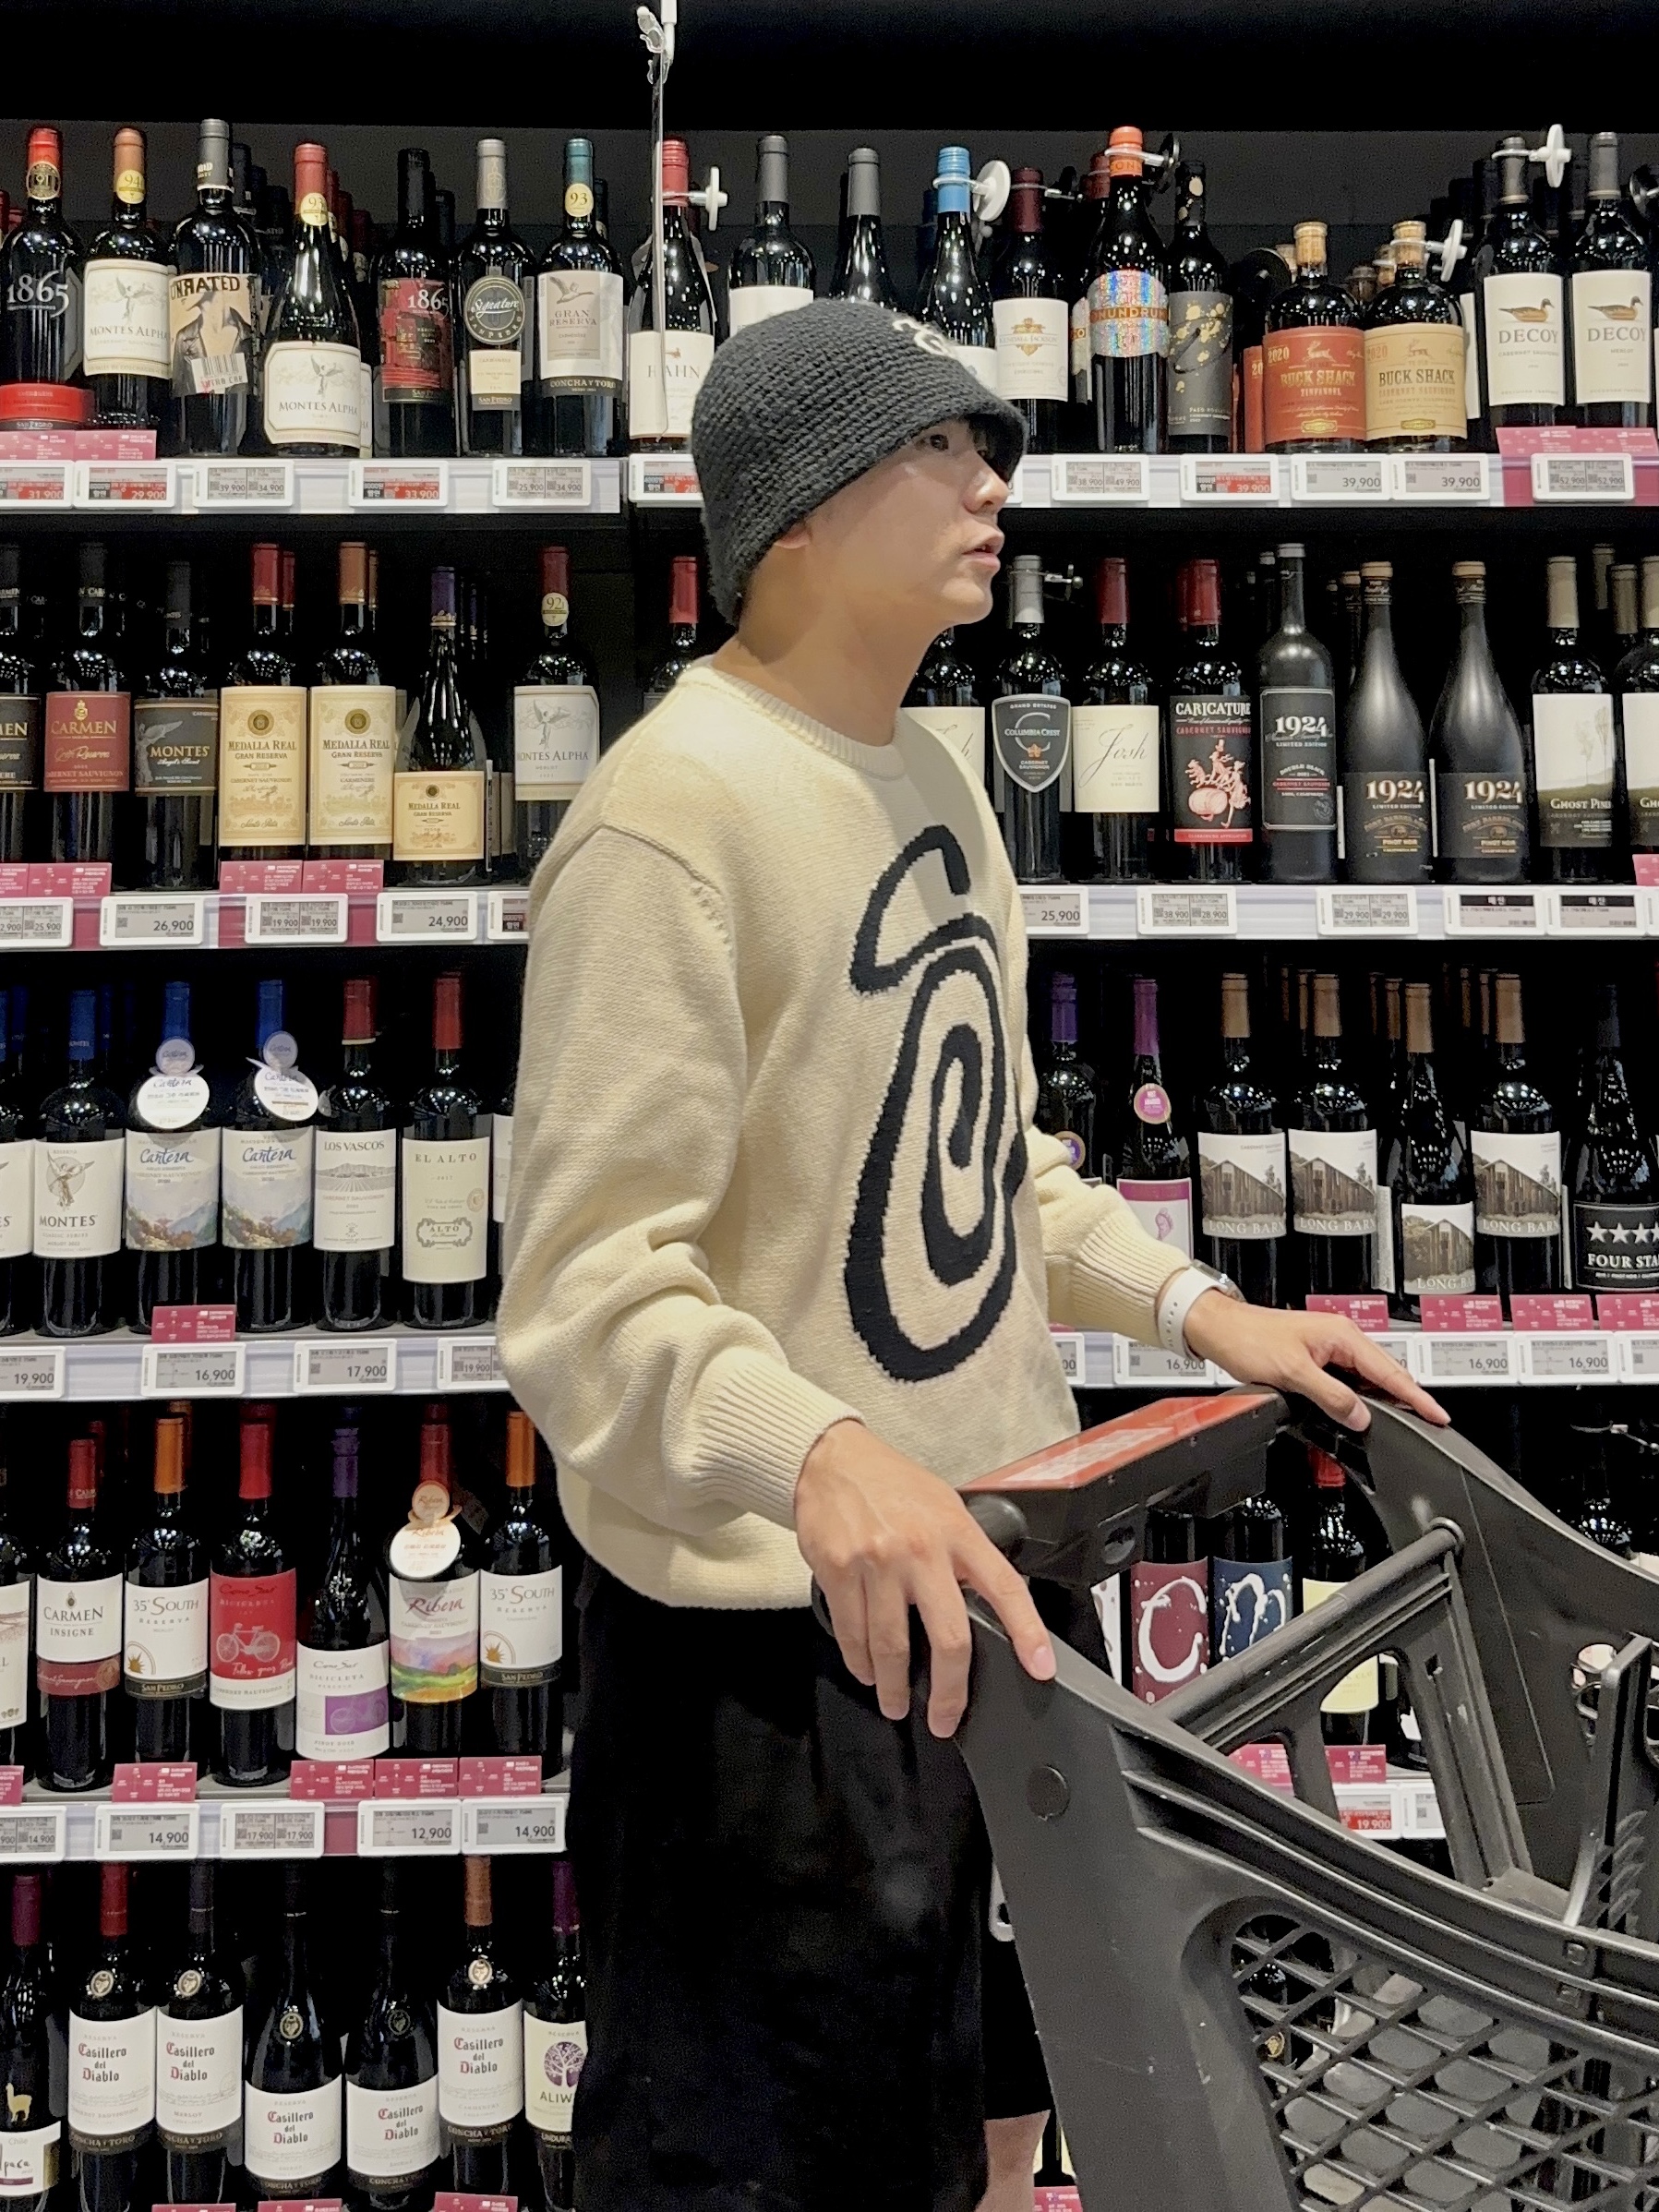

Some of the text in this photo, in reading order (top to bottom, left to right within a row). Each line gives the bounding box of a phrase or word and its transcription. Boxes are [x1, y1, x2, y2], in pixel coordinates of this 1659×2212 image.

[125, 175, 142, 190] 94
[308, 196, 325, 210] 93
[568, 191, 590, 205] 93
[7, 270, 68, 318] 1865
[408, 288, 450, 320] 1865
[475, 297, 520, 319] Signature
[555, 310, 590, 319] GRAN
[549, 319, 597, 328] RESERVA
[90, 325, 133, 336] MONTES
[1498, 329, 1559, 343] DECOY
[1588, 327, 1647, 343] DECOY
[1268, 347, 1290, 362] 2020
[648, 366, 700, 379] HAHN
[1280, 370, 1355, 387] BUCK SHACK
[1379, 370, 1455, 385] BUCK SHACK
[549, 379, 588, 388] CONCHA
[279, 402, 358, 415] MONTES ALPHA
[1078, 478, 1103, 487] 38,900
[1115, 478, 1140, 487] 49,900
[1342, 477, 1381, 488] 39,900
[1441, 477, 1480, 488] 39,900
[1560, 477, 1585, 487] 52,900
[1598, 477, 1623, 487] 52,900
[29, 490, 64, 499] 31,900
[131, 490, 166, 499] 29,900
[220, 484, 246, 493] 39,900
[258, 484, 284, 493] 34,900
[404, 490, 439, 499] 33,900
[519, 484, 544, 493] 25,900
[557, 484, 582, 493] 34,900
[1237, 484, 1270, 493] 39,900
[547, 597, 564, 610] 92
[1175, 702, 1251, 716] CARICATURE
[52, 720, 117, 735] CARMEN
[1275, 715, 1328, 737] 1924
[1004, 727, 1061, 738] COLUMBIA CREST
[229, 740, 298, 752] MEDALLA REAL
[322, 739, 391, 751] MEDALLA REAL
[150, 745, 210, 758] MONTES
[235, 752, 253, 761] GRAN
[331, 751, 352, 760] GRAN
[553, 750, 590, 762] ALPHA
[1078, 723, 1149, 788] Josh
[78, 770, 124, 778] SAUVIGNON
[1365, 780, 1425, 803] 1924
[1463, 780, 1522, 803] 1924
[408, 801, 462, 811] MEDALLA REAL
[1550, 798, 1589, 810] GHOST
[428, 915, 468, 927] 24,900
[1041, 910, 1080, 921] 25,900
[1164, 910, 1189, 920] 38,900
[1202, 910, 1227, 920] 28,900
[1344, 910, 1370, 920] 29,900
[1383, 910, 1408, 920] 29,900
[35, 921, 62, 931] 25,900
[154, 920, 194, 932] 26,900
[272, 918, 298, 928] 19,900
[311, 918, 337, 928] 19,900
[324, 1139, 385, 1151] LOS VASCOS
[140, 1148, 194, 1165] Cantera
[242, 1147, 296, 1163] Cantera
[415, 1152, 477, 1162] EL ALTO
[39, 1214, 96, 1228] MONTES
[1208, 1220, 1247, 1233] LONG
[1299, 1219, 1338, 1232] LONG
[1483, 1219, 1521, 1232] LONG
[430, 1225, 461, 1233] ALTO
[1587, 1254, 1632, 1268] FOUR
[1417, 1280, 1458, 1292] LONG
[463, 1364, 490, 1374] 19,900
[1166, 1359, 1206, 1371] 16,900
[1469, 1358, 1508, 1370] 16,900
[1569, 1357, 1608, 1369] 16,900
[195, 1369, 235, 1381] 16,900
[346, 1364, 388, 1377] 17,900
[14, 1374, 54, 1385] 19,900
[511, 1583, 554, 1605] SOUTH
[150, 1594, 199, 1616] SOUTH
[403, 1596, 465, 1617] Ribera
[43, 1606, 104, 1622] CARMEN
[50, 1628, 95, 1638] INSIGNE
[501, 1672, 544, 1684] SAN PEDRO
[142, 1681, 186, 1693] SAN PEDRO
[514, 1824, 555, 1838] 14,900
[1356, 1820, 1389, 1830] 19,900
[149, 1831, 189, 1844] 14,900
[246, 1832, 274, 1842] 17,900
[286, 1831, 314, 1841] 17,900
[411, 1826, 451, 1840] 12,900
[29, 1834, 55, 1845] 14,900
[78, 2042, 127, 2061] Casillero
[165, 2041, 215, 2059] Casillero
[453, 2037, 504, 2055] Casillero
[473, 2053, 485, 2062] del
[95, 2061, 106, 2070] del
[183, 2060, 194, 2069] del
[460, 2061, 498, 2078] Diablo
[82, 2067, 120, 2084] Diablo
[170, 2066, 208, 2082] Diablo
[379, 2104, 424, 2122] Casillero
[268, 2110, 314, 2129] Casillero
[396, 2120, 407, 2129] del
[284, 2124, 295, 2134] del
[384, 2126, 419, 2143] Diablo
[273, 2132, 308, 2148] Diablo
